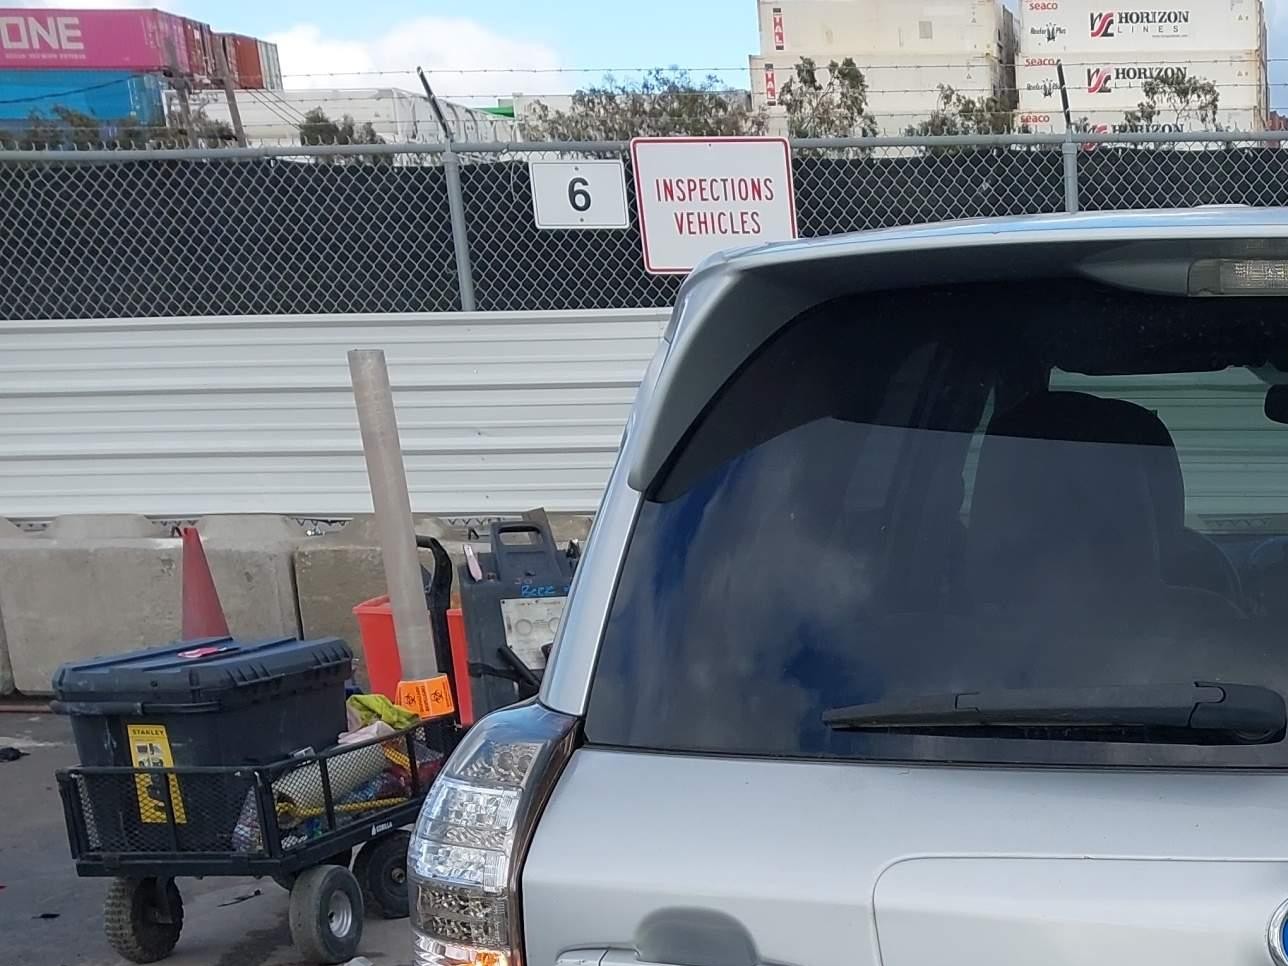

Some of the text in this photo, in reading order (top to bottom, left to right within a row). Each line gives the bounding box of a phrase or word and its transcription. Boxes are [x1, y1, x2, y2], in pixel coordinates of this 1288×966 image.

[1029, 2, 1058, 10] seaco
[1117, 11, 1190, 24] HORIZON
[0, 16, 84, 50] ONE
[1117, 25, 1179, 33] LINES
[1025, 58, 1055, 67] seaco
[1115, 67, 1187, 80] HORIZON
[1020, 115, 1050, 123] seaco
[568, 177, 592, 212] 6
[655, 177, 774, 203] INSPECTIONS
[673, 211, 761, 235] VEHICLES
[132, 728, 165, 737] STANLEY
